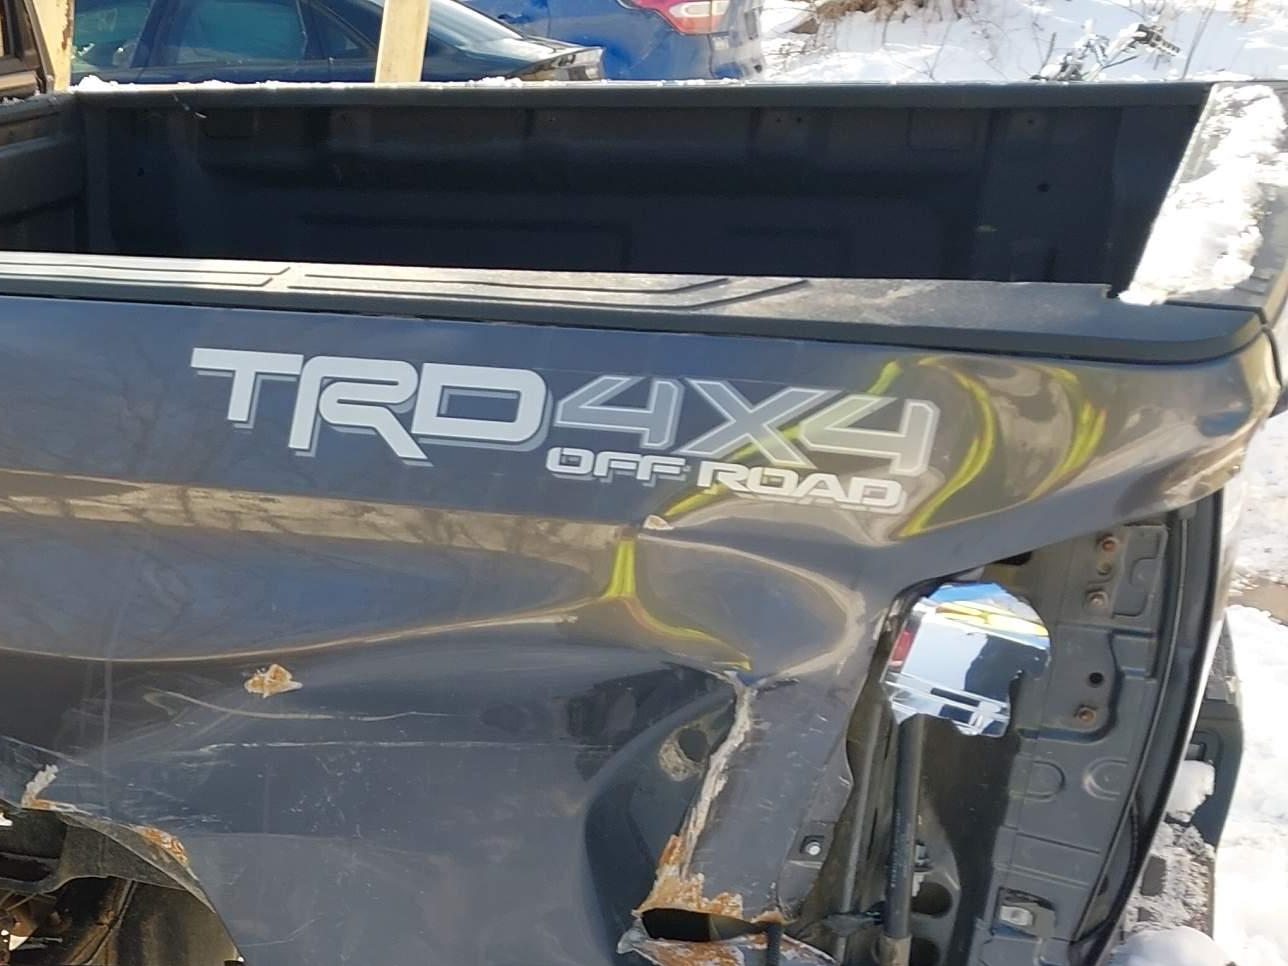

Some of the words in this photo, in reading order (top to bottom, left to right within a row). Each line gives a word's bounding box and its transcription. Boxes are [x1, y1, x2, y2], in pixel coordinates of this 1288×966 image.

[190, 347, 554, 467] TRD
[545, 446, 692, 487] OFF
[697, 460, 908, 513] ROAD
